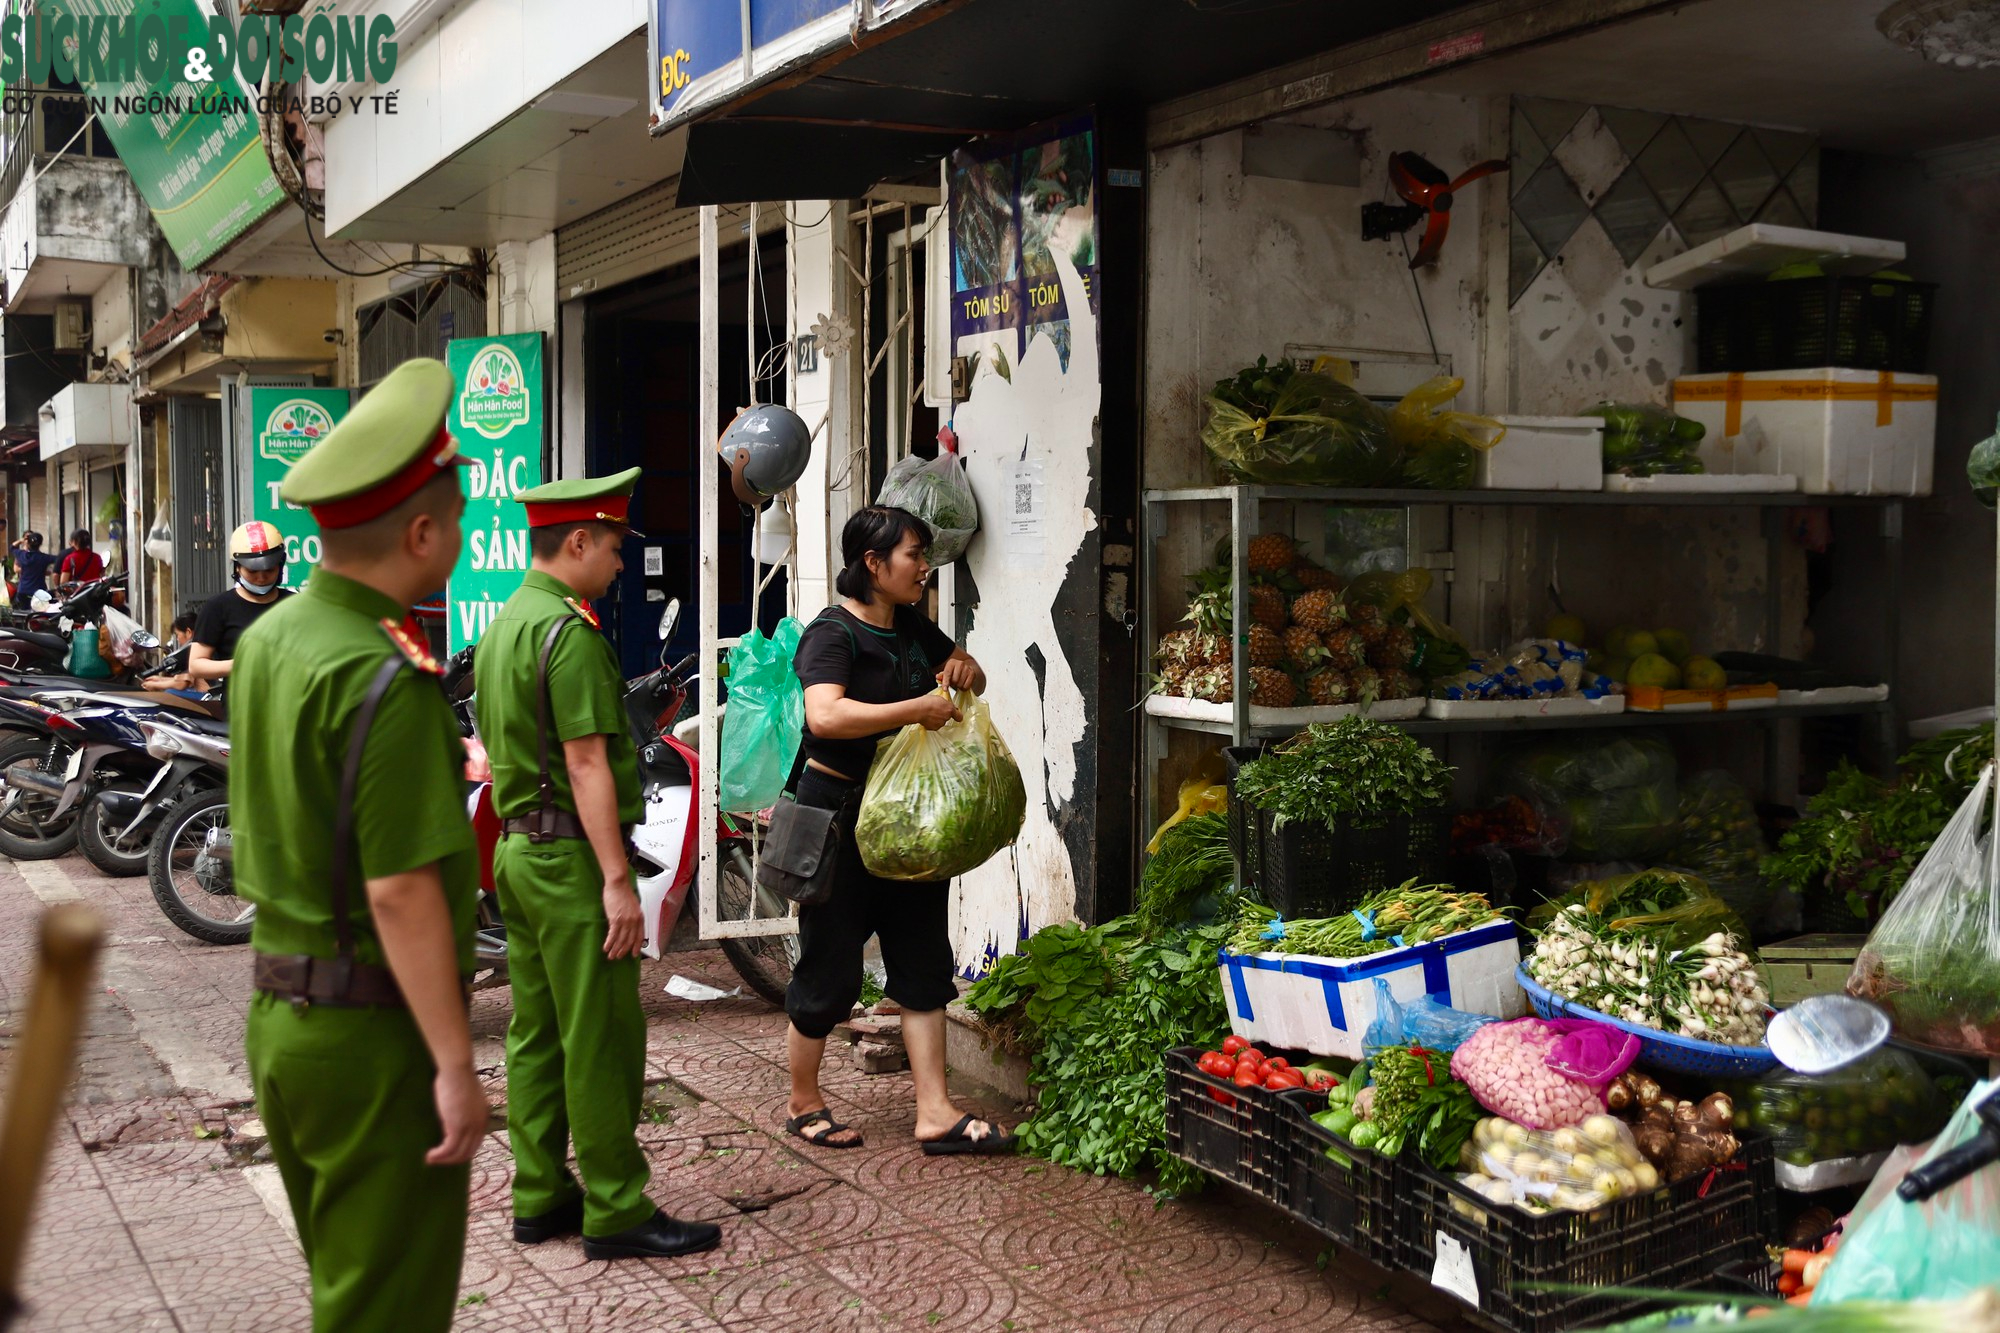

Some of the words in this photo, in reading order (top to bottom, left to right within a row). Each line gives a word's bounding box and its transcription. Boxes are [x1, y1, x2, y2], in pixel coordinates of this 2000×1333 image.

[661, 48, 690, 97] ĐC:
[964, 295, 990, 320] TÔM
[993, 289, 1010, 315] SÚ
[1028, 282, 1059, 308] TÔM
[800, 340, 814, 371] 21
[502, 398, 523, 410] Food
[470, 449, 527, 507] ĐẶC
[470, 516, 527, 570] SẢN
